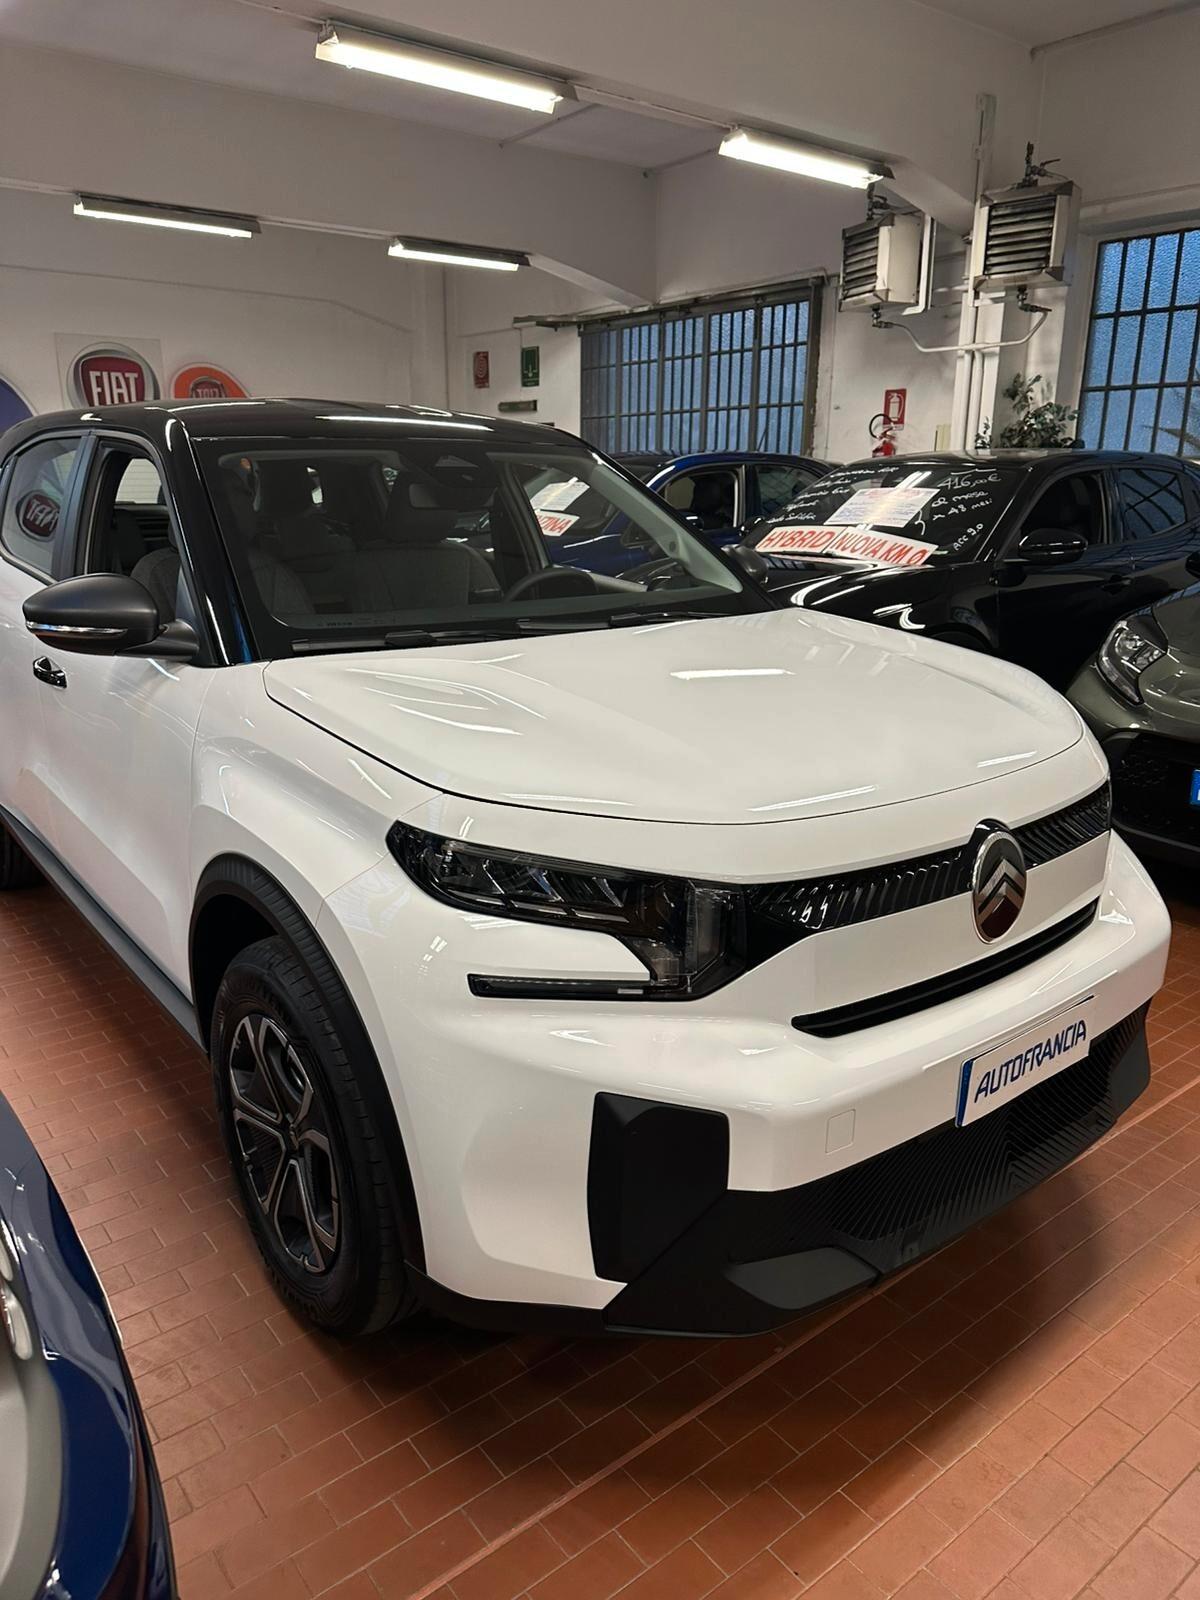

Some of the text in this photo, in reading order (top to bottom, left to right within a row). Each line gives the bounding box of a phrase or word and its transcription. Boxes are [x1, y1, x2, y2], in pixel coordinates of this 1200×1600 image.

[89, 370, 139, 406] FIAT
[762, 530, 836, 550] HYBRID
[830, 532, 888, 558] NUOVA
[879, 542, 914, 564] KM
[974, 1019, 1087, 1103] AUTOFRANCIA
